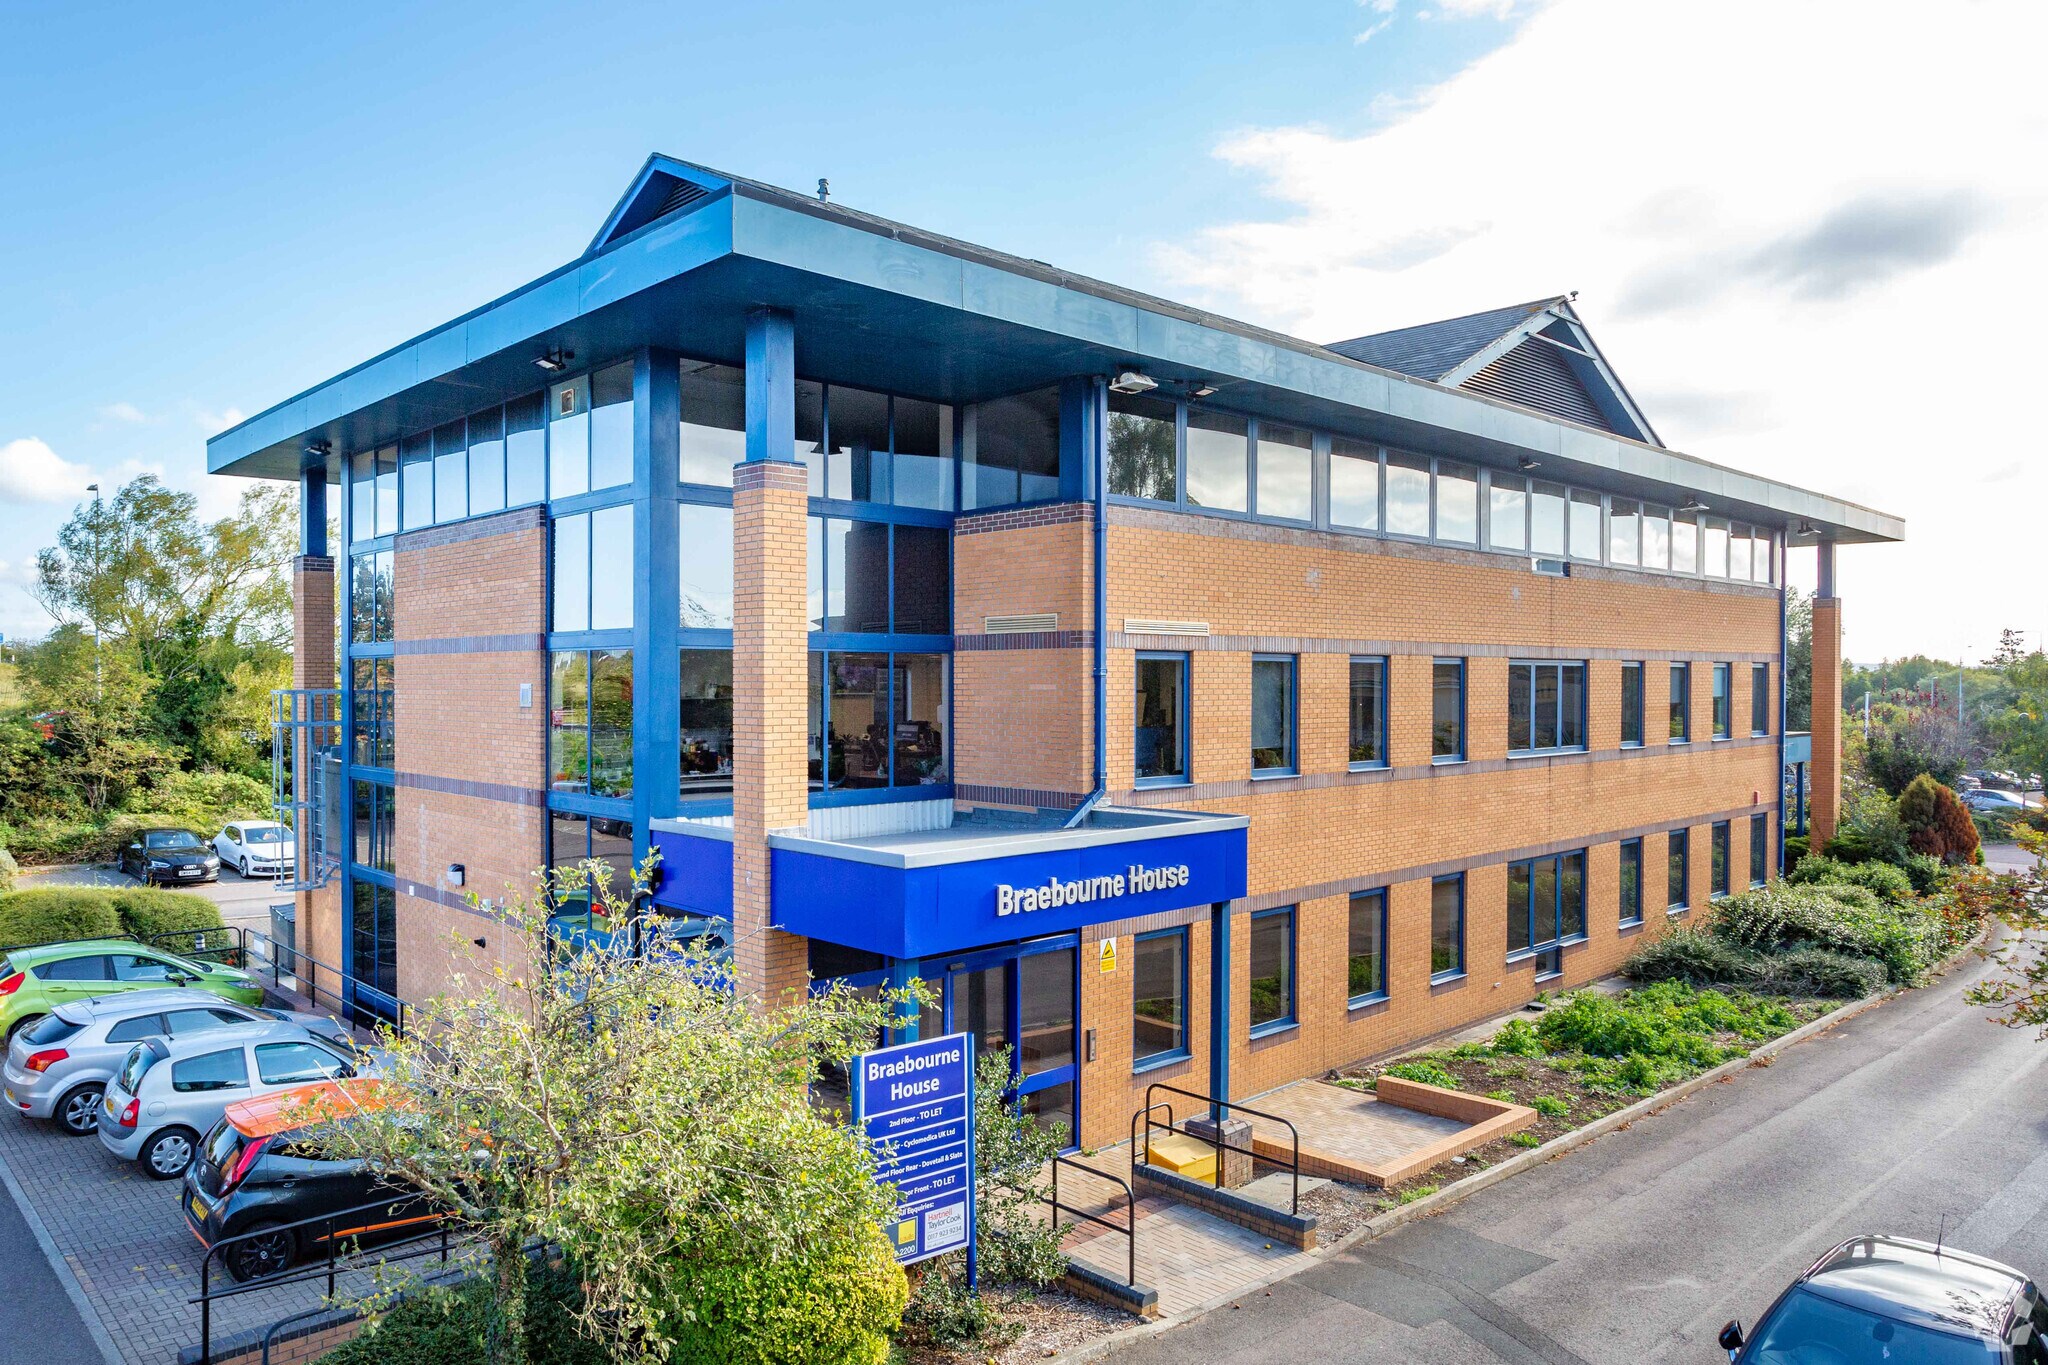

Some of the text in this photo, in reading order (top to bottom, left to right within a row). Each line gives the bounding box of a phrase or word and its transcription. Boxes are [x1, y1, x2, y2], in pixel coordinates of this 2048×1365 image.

[996, 864, 1190, 917] Braebourne House
[868, 1049, 960, 1081] Braebourne
[891, 1078, 940, 1101] House
[889, 1118, 900, 1128] 2nd
[901, 1115, 915, 1126] Floor
[920, 1110, 930, 1120] TO
[930, 1107, 943, 1117] LET
[903, 1134, 938, 1148] Cyclomedica
[938, 1130, 946, 1139] UK
[946, 1128, 956, 1136] Ltd
[871, 1170, 890, 1181] round
[890, 1168, 905, 1177] Floor
[905, 1164, 918, 1172] Rear
[914, 1184, 929, 1194] Front
[932, 1179, 943, 1189] TO
[943, 1175, 956, 1185] LET
[927, 1208, 953, 1221] Hartnell
[928, 1213, 962, 1230] Taylor Cook
